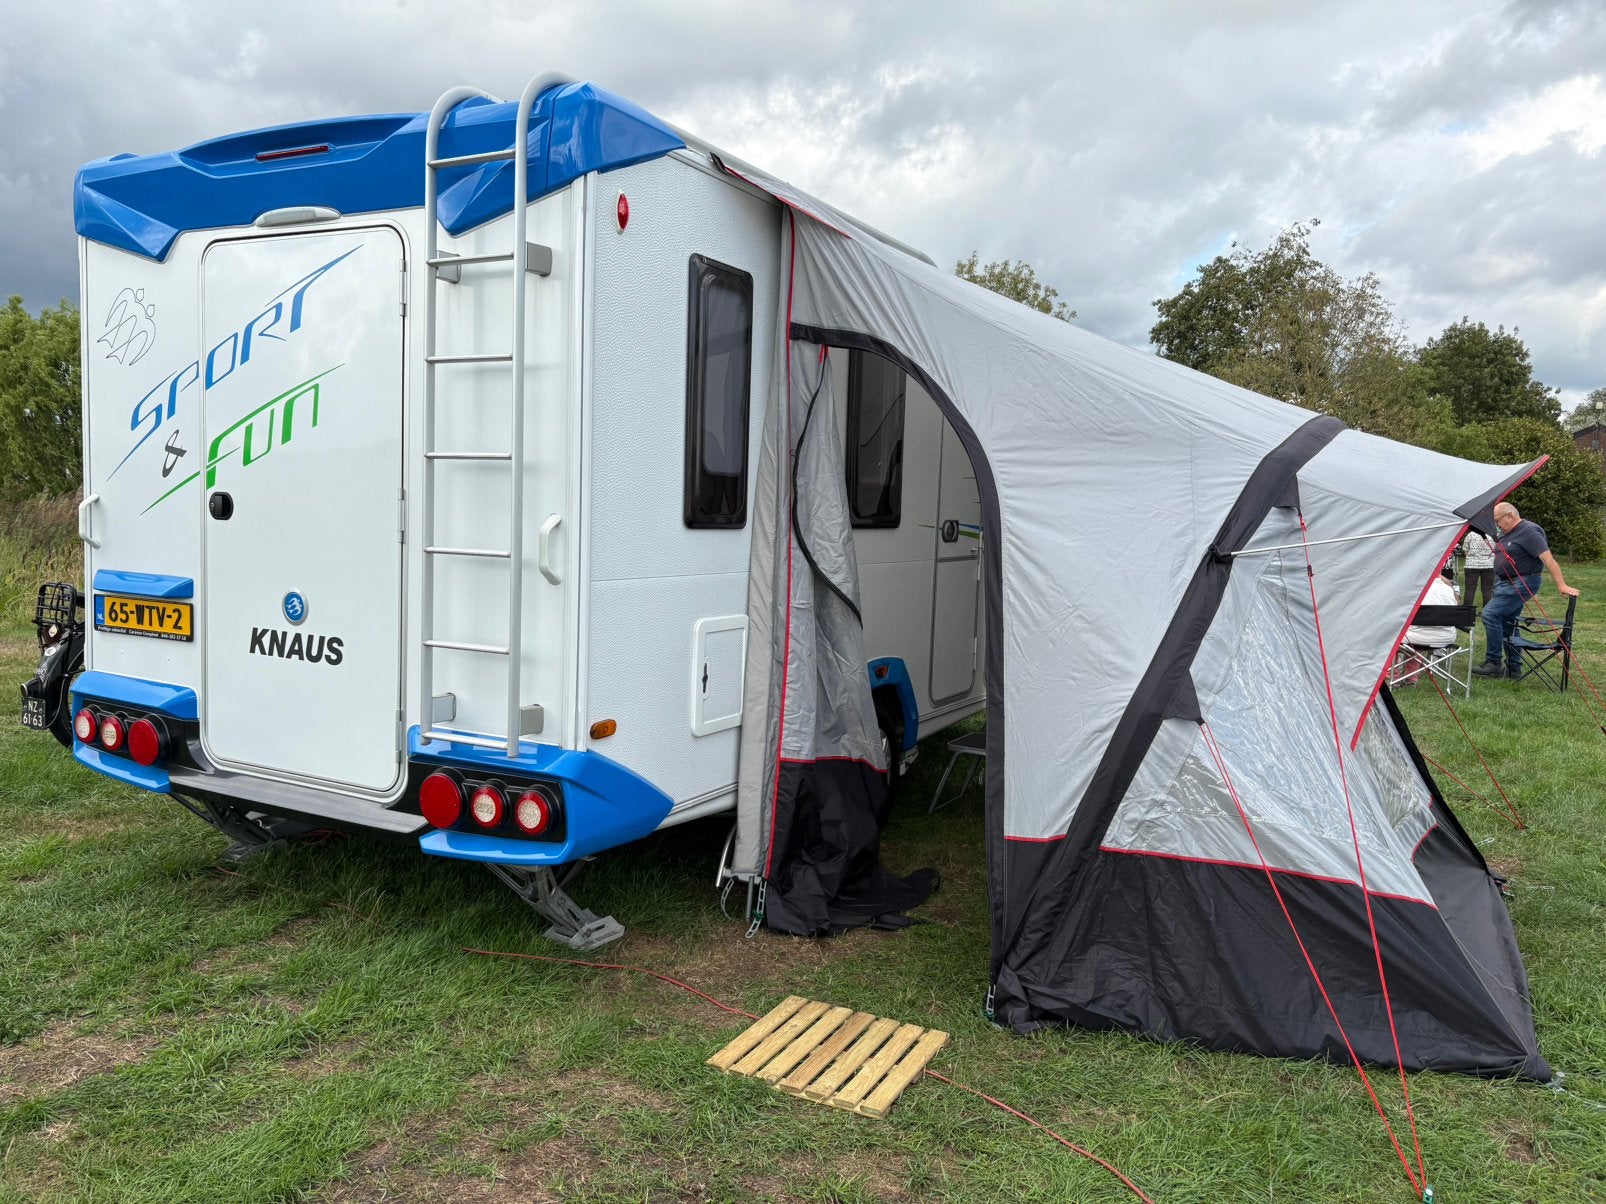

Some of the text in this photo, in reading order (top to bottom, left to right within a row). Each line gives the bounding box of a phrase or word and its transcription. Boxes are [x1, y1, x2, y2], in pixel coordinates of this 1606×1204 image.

[107, 244, 364, 482] SPORT
[162, 429, 188, 478] &
[108, 601, 183, 630] 65-WTV-2
[249, 627, 344, 666] KNAUS
[28, 700, 38, 713] NZ
